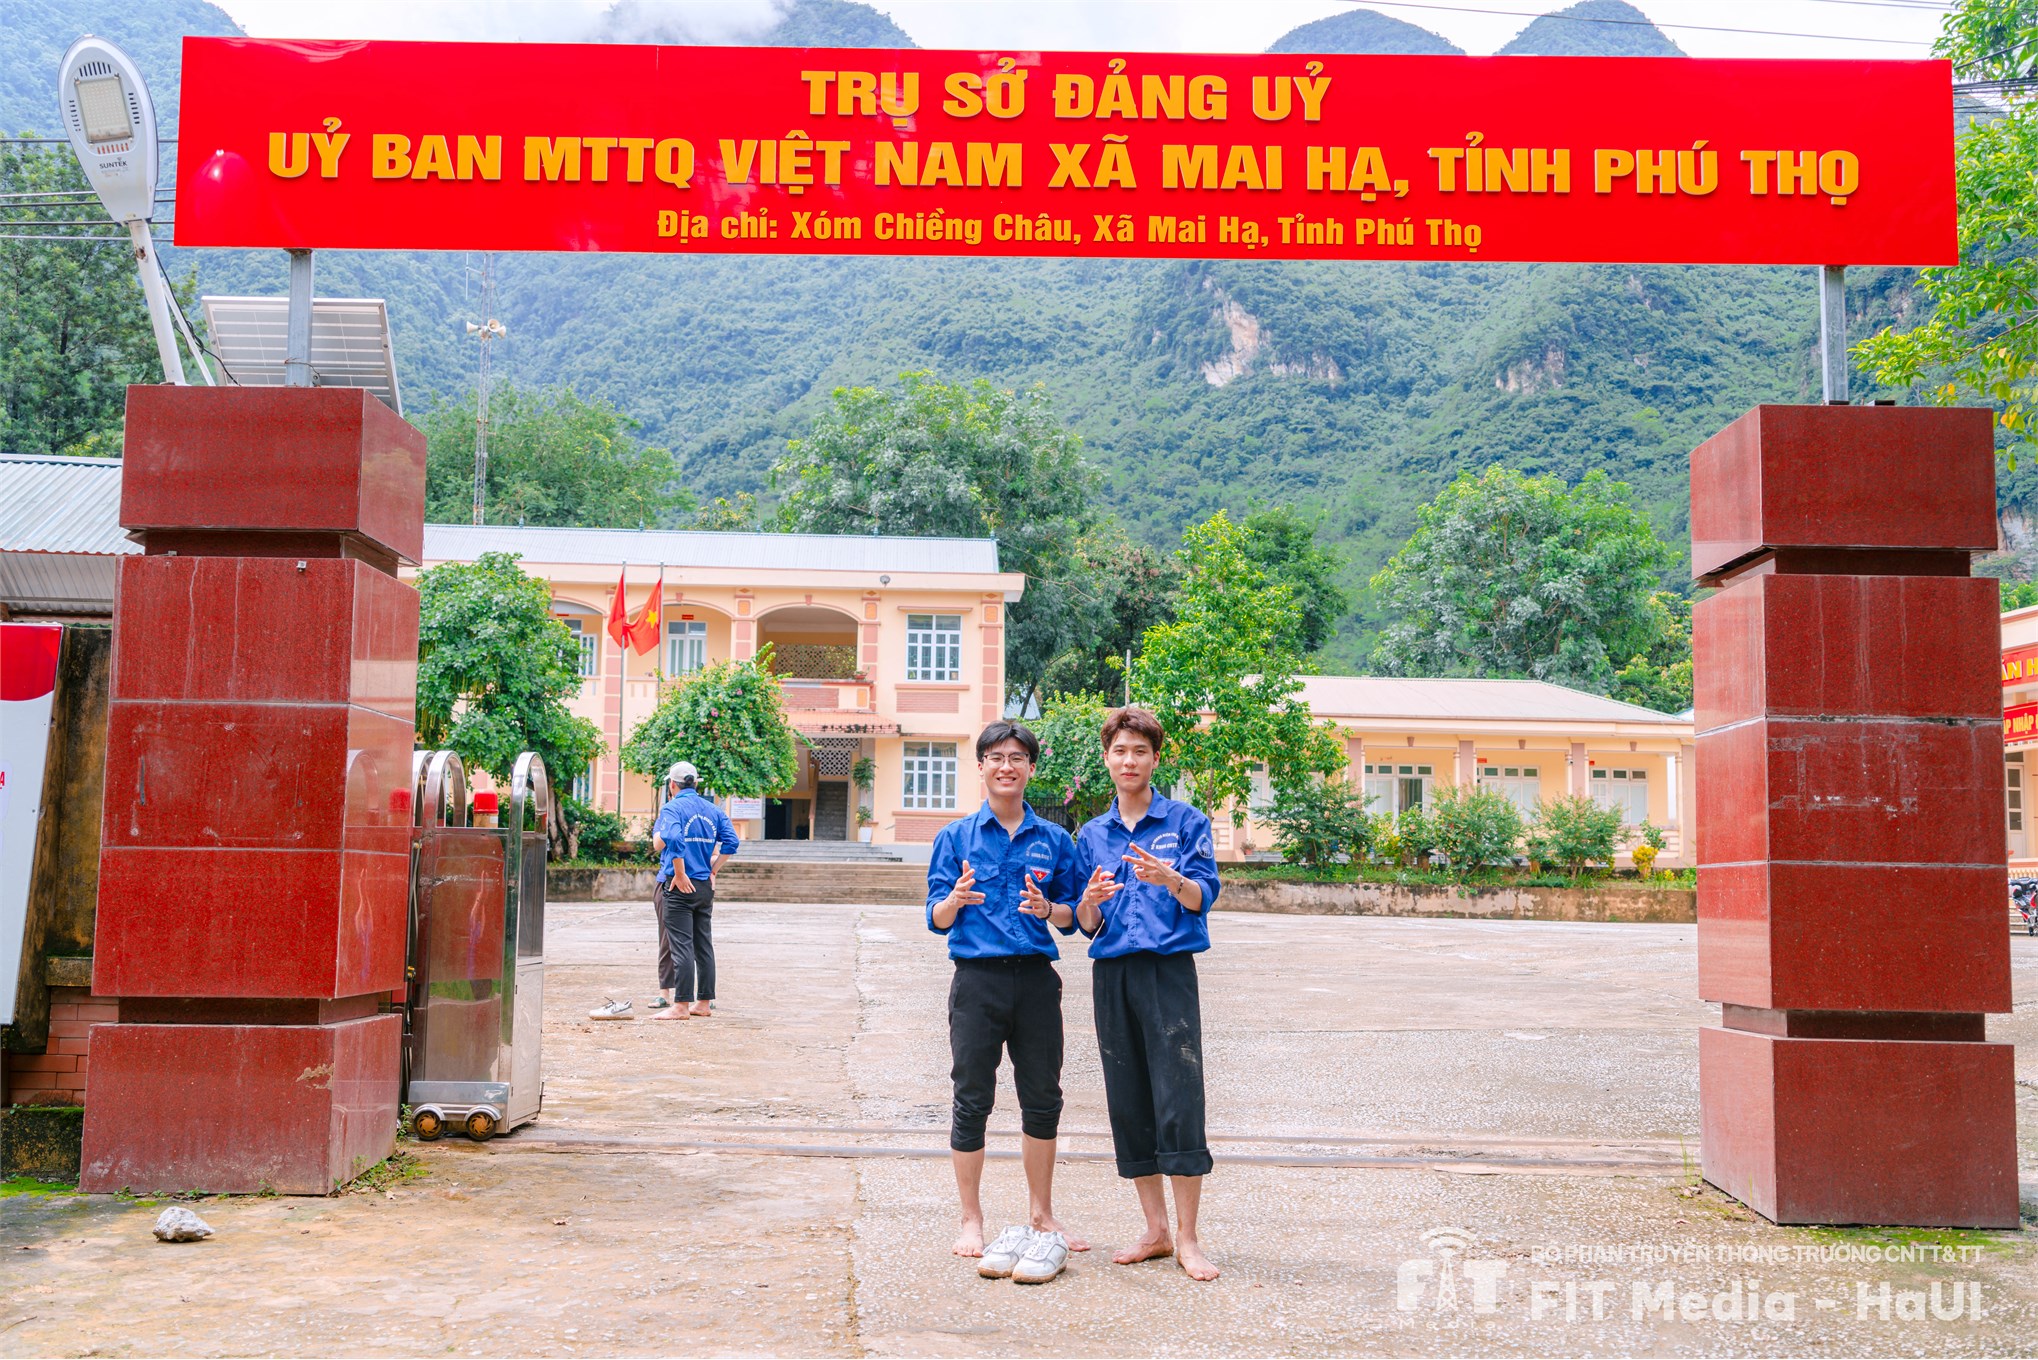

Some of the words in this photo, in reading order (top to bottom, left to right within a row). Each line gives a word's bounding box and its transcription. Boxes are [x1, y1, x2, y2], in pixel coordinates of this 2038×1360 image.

[801, 70, 918, 126] TRỤ
[943, 57, 1028, 118] SỞ
[1052, 58, 1227, 119] ĐẢNG
[1251, 61, 1332, 121] UỶ
[99, 160, 128, 169] SUNTEK
[268, 116, 349, 178] UỶ
[372, 133, 502, 181] BAN
[523, 136, 694, 189] MTTQ
[719, 130, 851, 194] VIỆT
[874, 141, 1023, 188] NAM
[1048, 133, 1137, 189] XÃ
[1162, 144, 1283, 190] MAI
[1307, 146, 1409, 202] HẠ,
[1428, 131, 1571, 193] TỈNH
[1595, 140, 1718, 195] PHÚ
[1741, 150, 1859, 206] THỌ
[657, 210, 709, 243] Địa
[721, 207, 778, 239] chỉ:
[790, 211, 862, 240] Xóm
[874, 207, 982, 245] Chiềng
[993, 213, 1081, 245] Châu,
[1093, 214, 1134, 242] Xã
[1148, 215, 1206, 243] Mai
[1219, 216, 1269, 250] Hạ,
[1277, 213, 1344, 246] Tỉnh
[1355, 217, 1414, 246] Phú
[1425, 219, 1482, 254] Thọ
